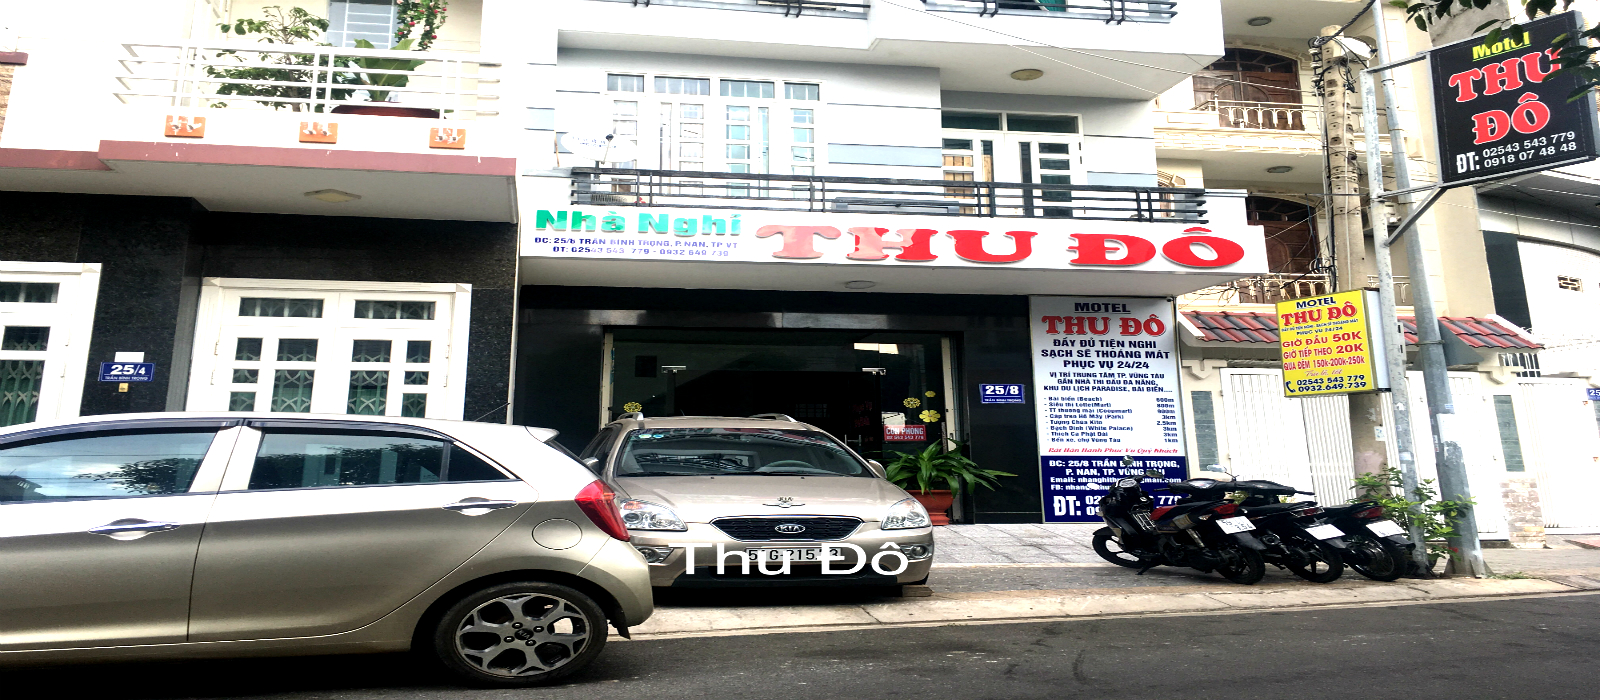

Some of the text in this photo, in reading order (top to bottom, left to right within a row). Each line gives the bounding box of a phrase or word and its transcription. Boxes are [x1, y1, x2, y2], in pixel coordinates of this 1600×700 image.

[1449, 48, 1563, 102] THU
[1472, 92, 1550, 145] ĐÔ
[1456, 131, 1576, 174] ĐT: 02543 543 779
[1484, 142, 1577, 168] 0918 07 48 48
[536, 210, 626, 232] Nhà
[755, 224, 1245, 268] THU ĐÔ
[1074, 302, 1131, 313] MOTEL
[1296, 297, 1336, 308] MOTEL
[1281, 301, 1358, 326] THU ĐÔ
[1041, 314, 1166, 337] THU ĐÔ
[1080, 337, 1096, 348] ĐỦ
[1100, 338, 1125, 350] TIỆN
[1128, 340, 1156, 348] NGHI
[1282, 338, 1303, 348] GIỜ
[1332, 331, 1363, 342] 50K
[1040, 349, 1073, 358] SẠCH
[1096, 350, 1142, 359] THOÁNG
[1144, 350, 1170, 360] MÁT
[1283, 343, 1364, 359] GIỜ TIẾP THEO 20K
[110, 364, 146, 375] 25/4
[1063, 360, 1150, 370] PHỤC VỤ 24/24
[1284, 356, 1365, 371] QUA ĐÊM 150k-200k-250k
[985, 385, 1019, 395] 25/8
[1298, 382, 1366, 392] 0932.649.739
[901, 426, 923, 435] PHÒNG
[1053, 496, 1082, 516] ĐT:
[518, 630, 530, 639] KIA
